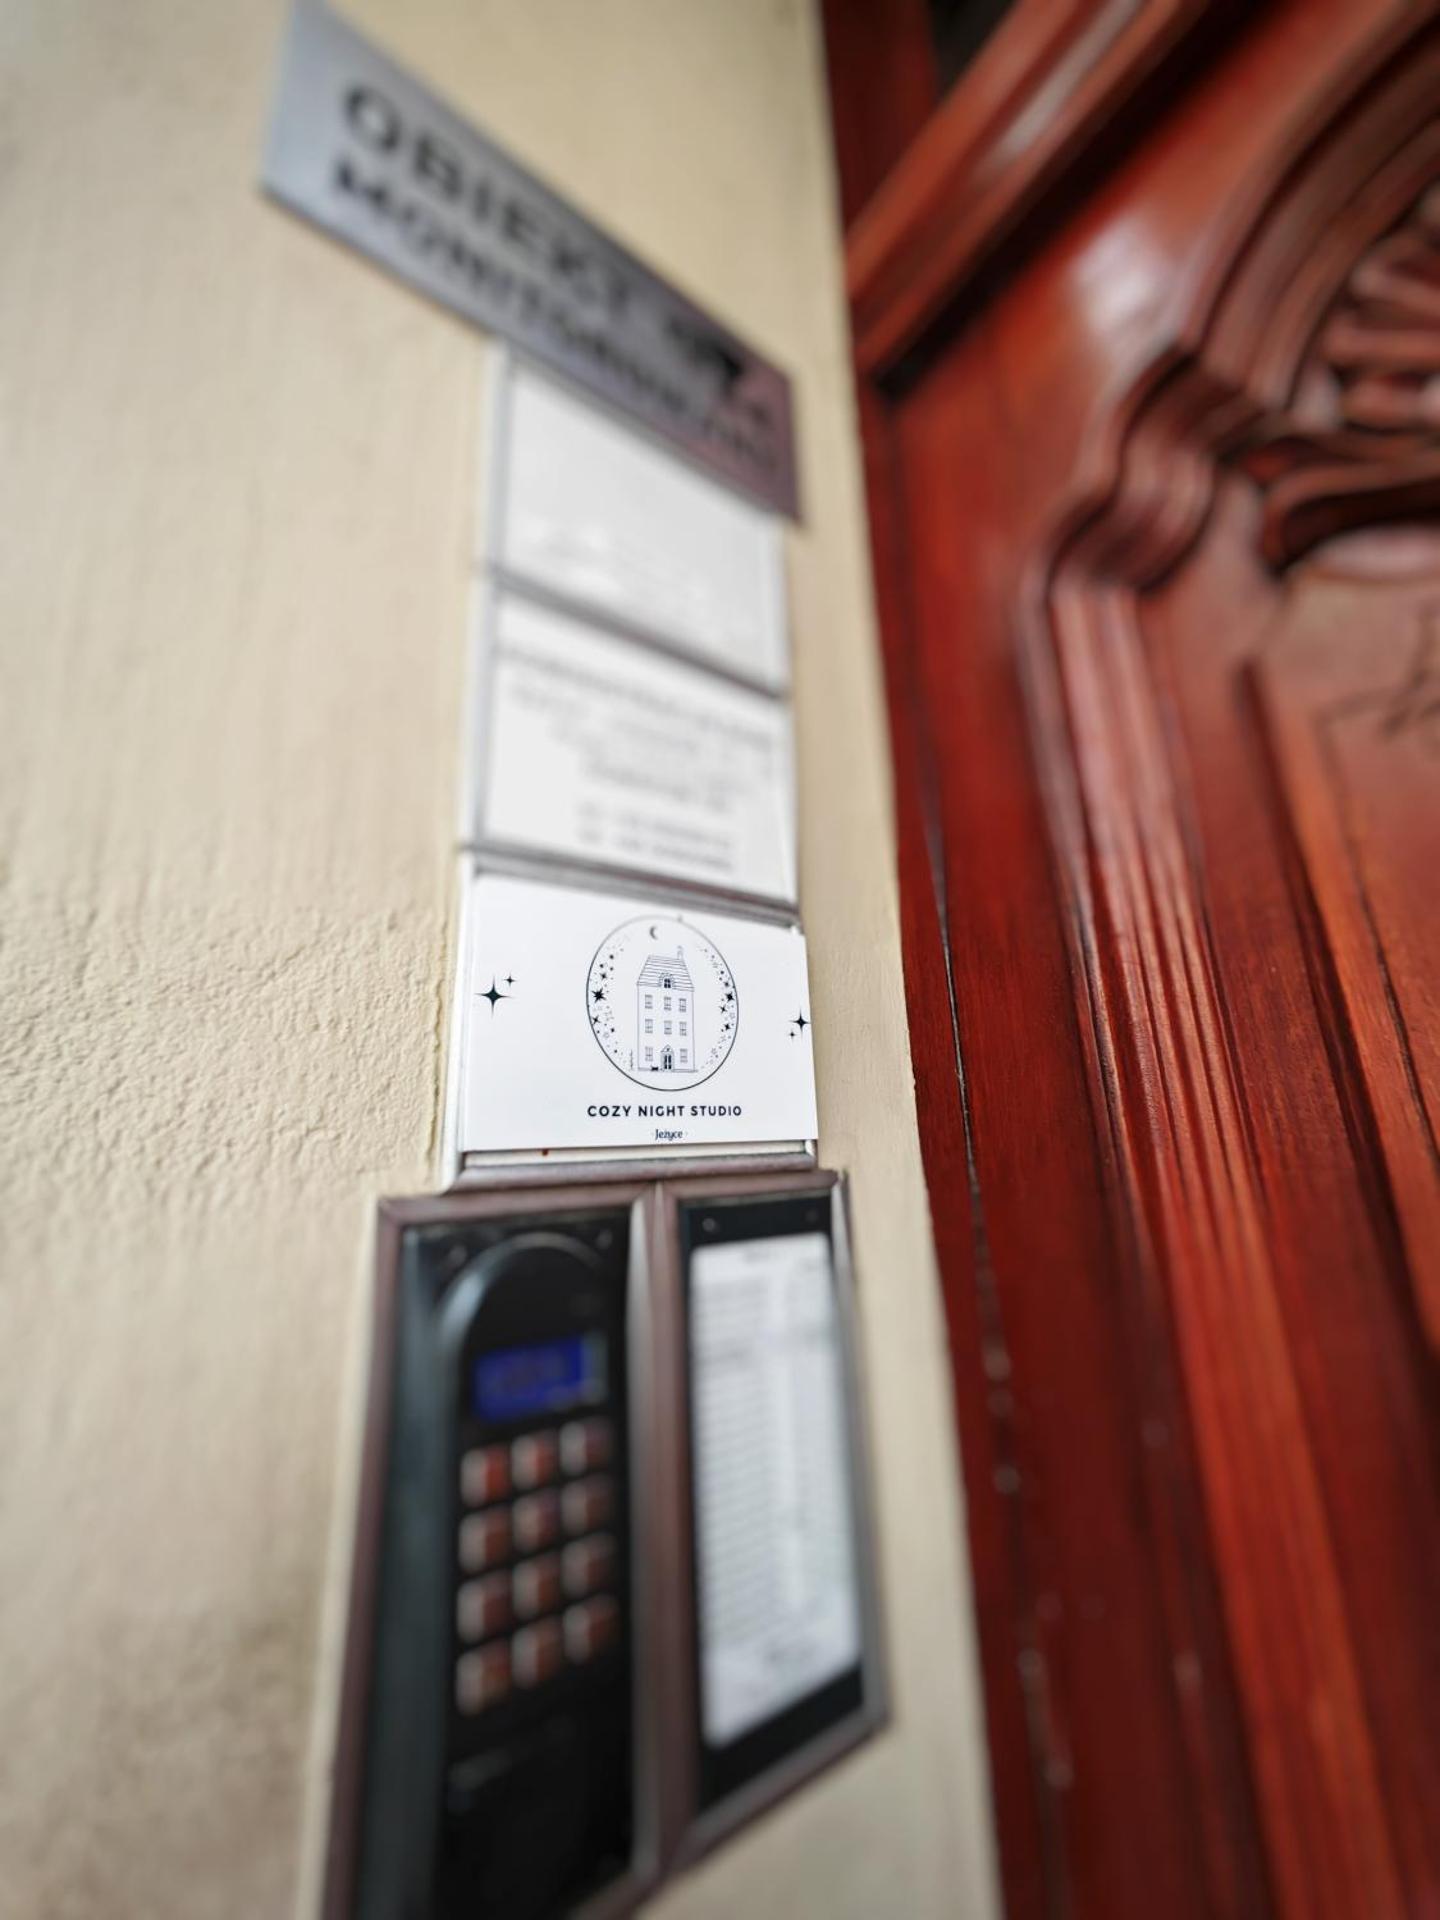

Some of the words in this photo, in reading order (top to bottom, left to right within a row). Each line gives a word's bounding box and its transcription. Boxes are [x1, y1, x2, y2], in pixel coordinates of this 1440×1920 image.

[587, 1105, 632, 1118] COZY
[638, 1105, 685, 1117] NIGHT
[690, 1105, 742, 1117] STUDIO
